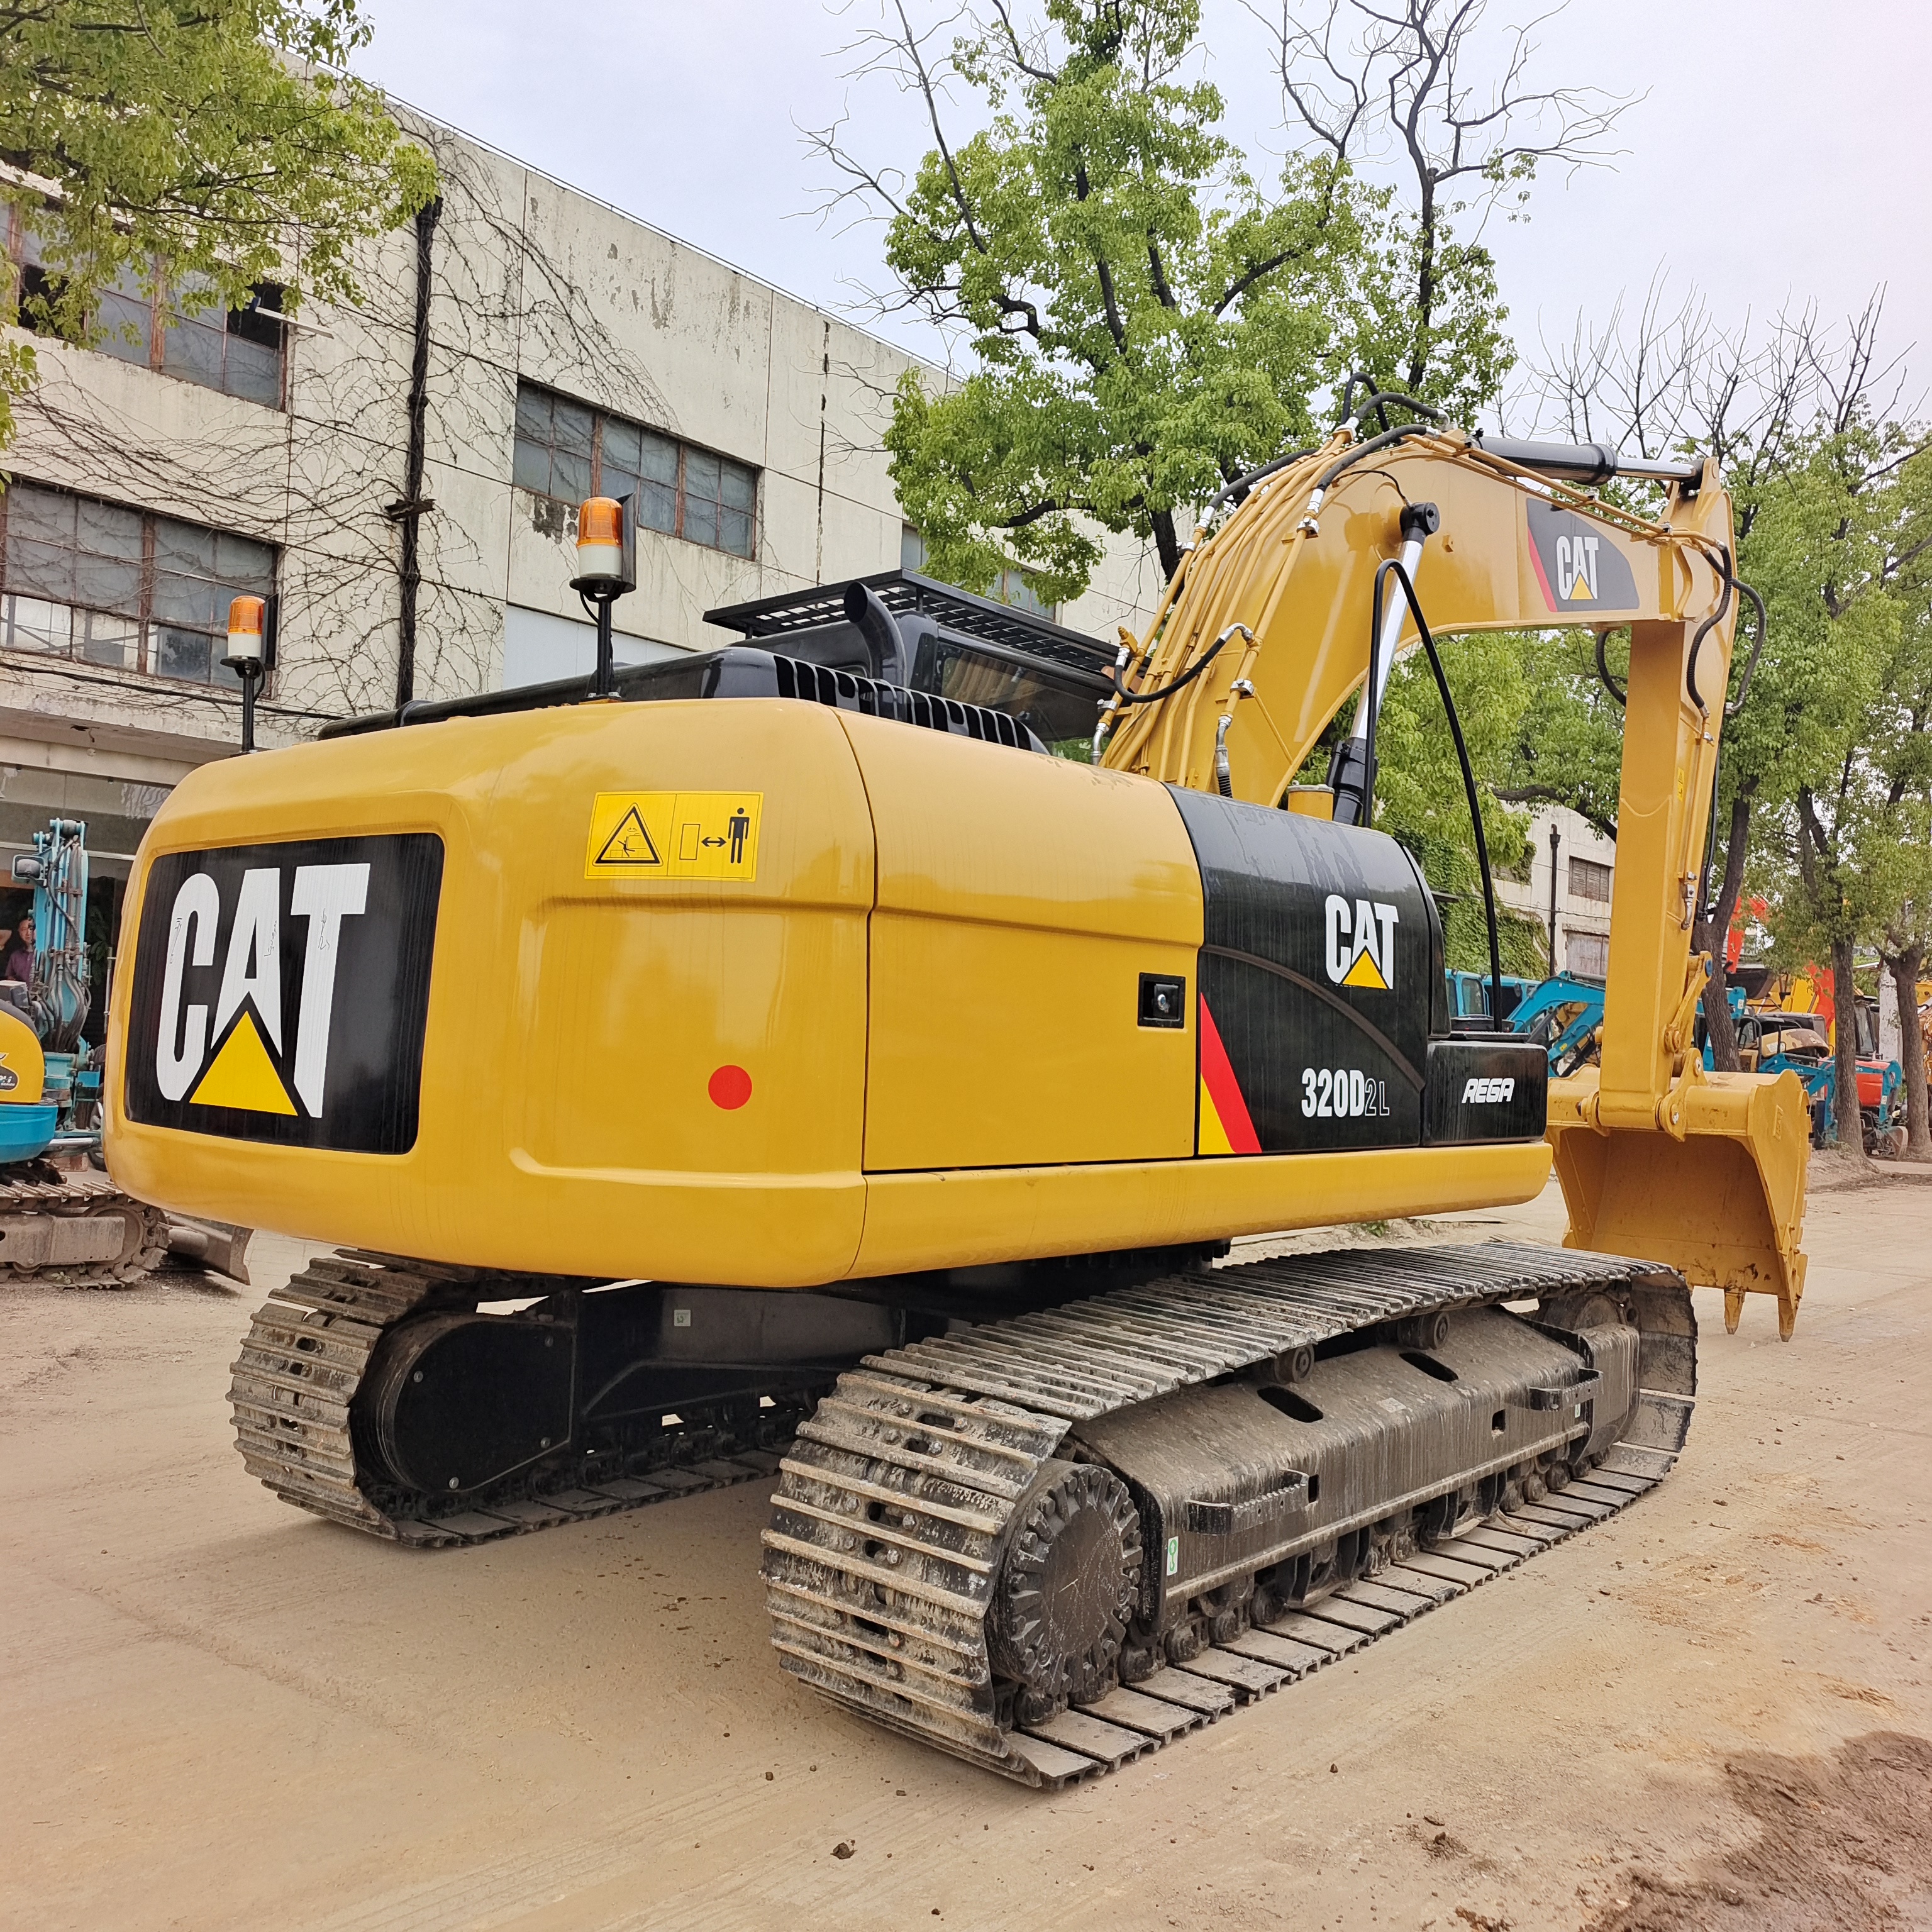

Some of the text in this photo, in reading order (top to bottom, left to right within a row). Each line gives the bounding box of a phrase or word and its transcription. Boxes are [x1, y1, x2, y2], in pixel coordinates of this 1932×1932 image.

[1556, 535, 1599, 600] CAT
[1325, 894, 1399, 990] CAT
[156, 863, 370, 1118] CAT
[1461, 1077, 1515, 1104] REGA
